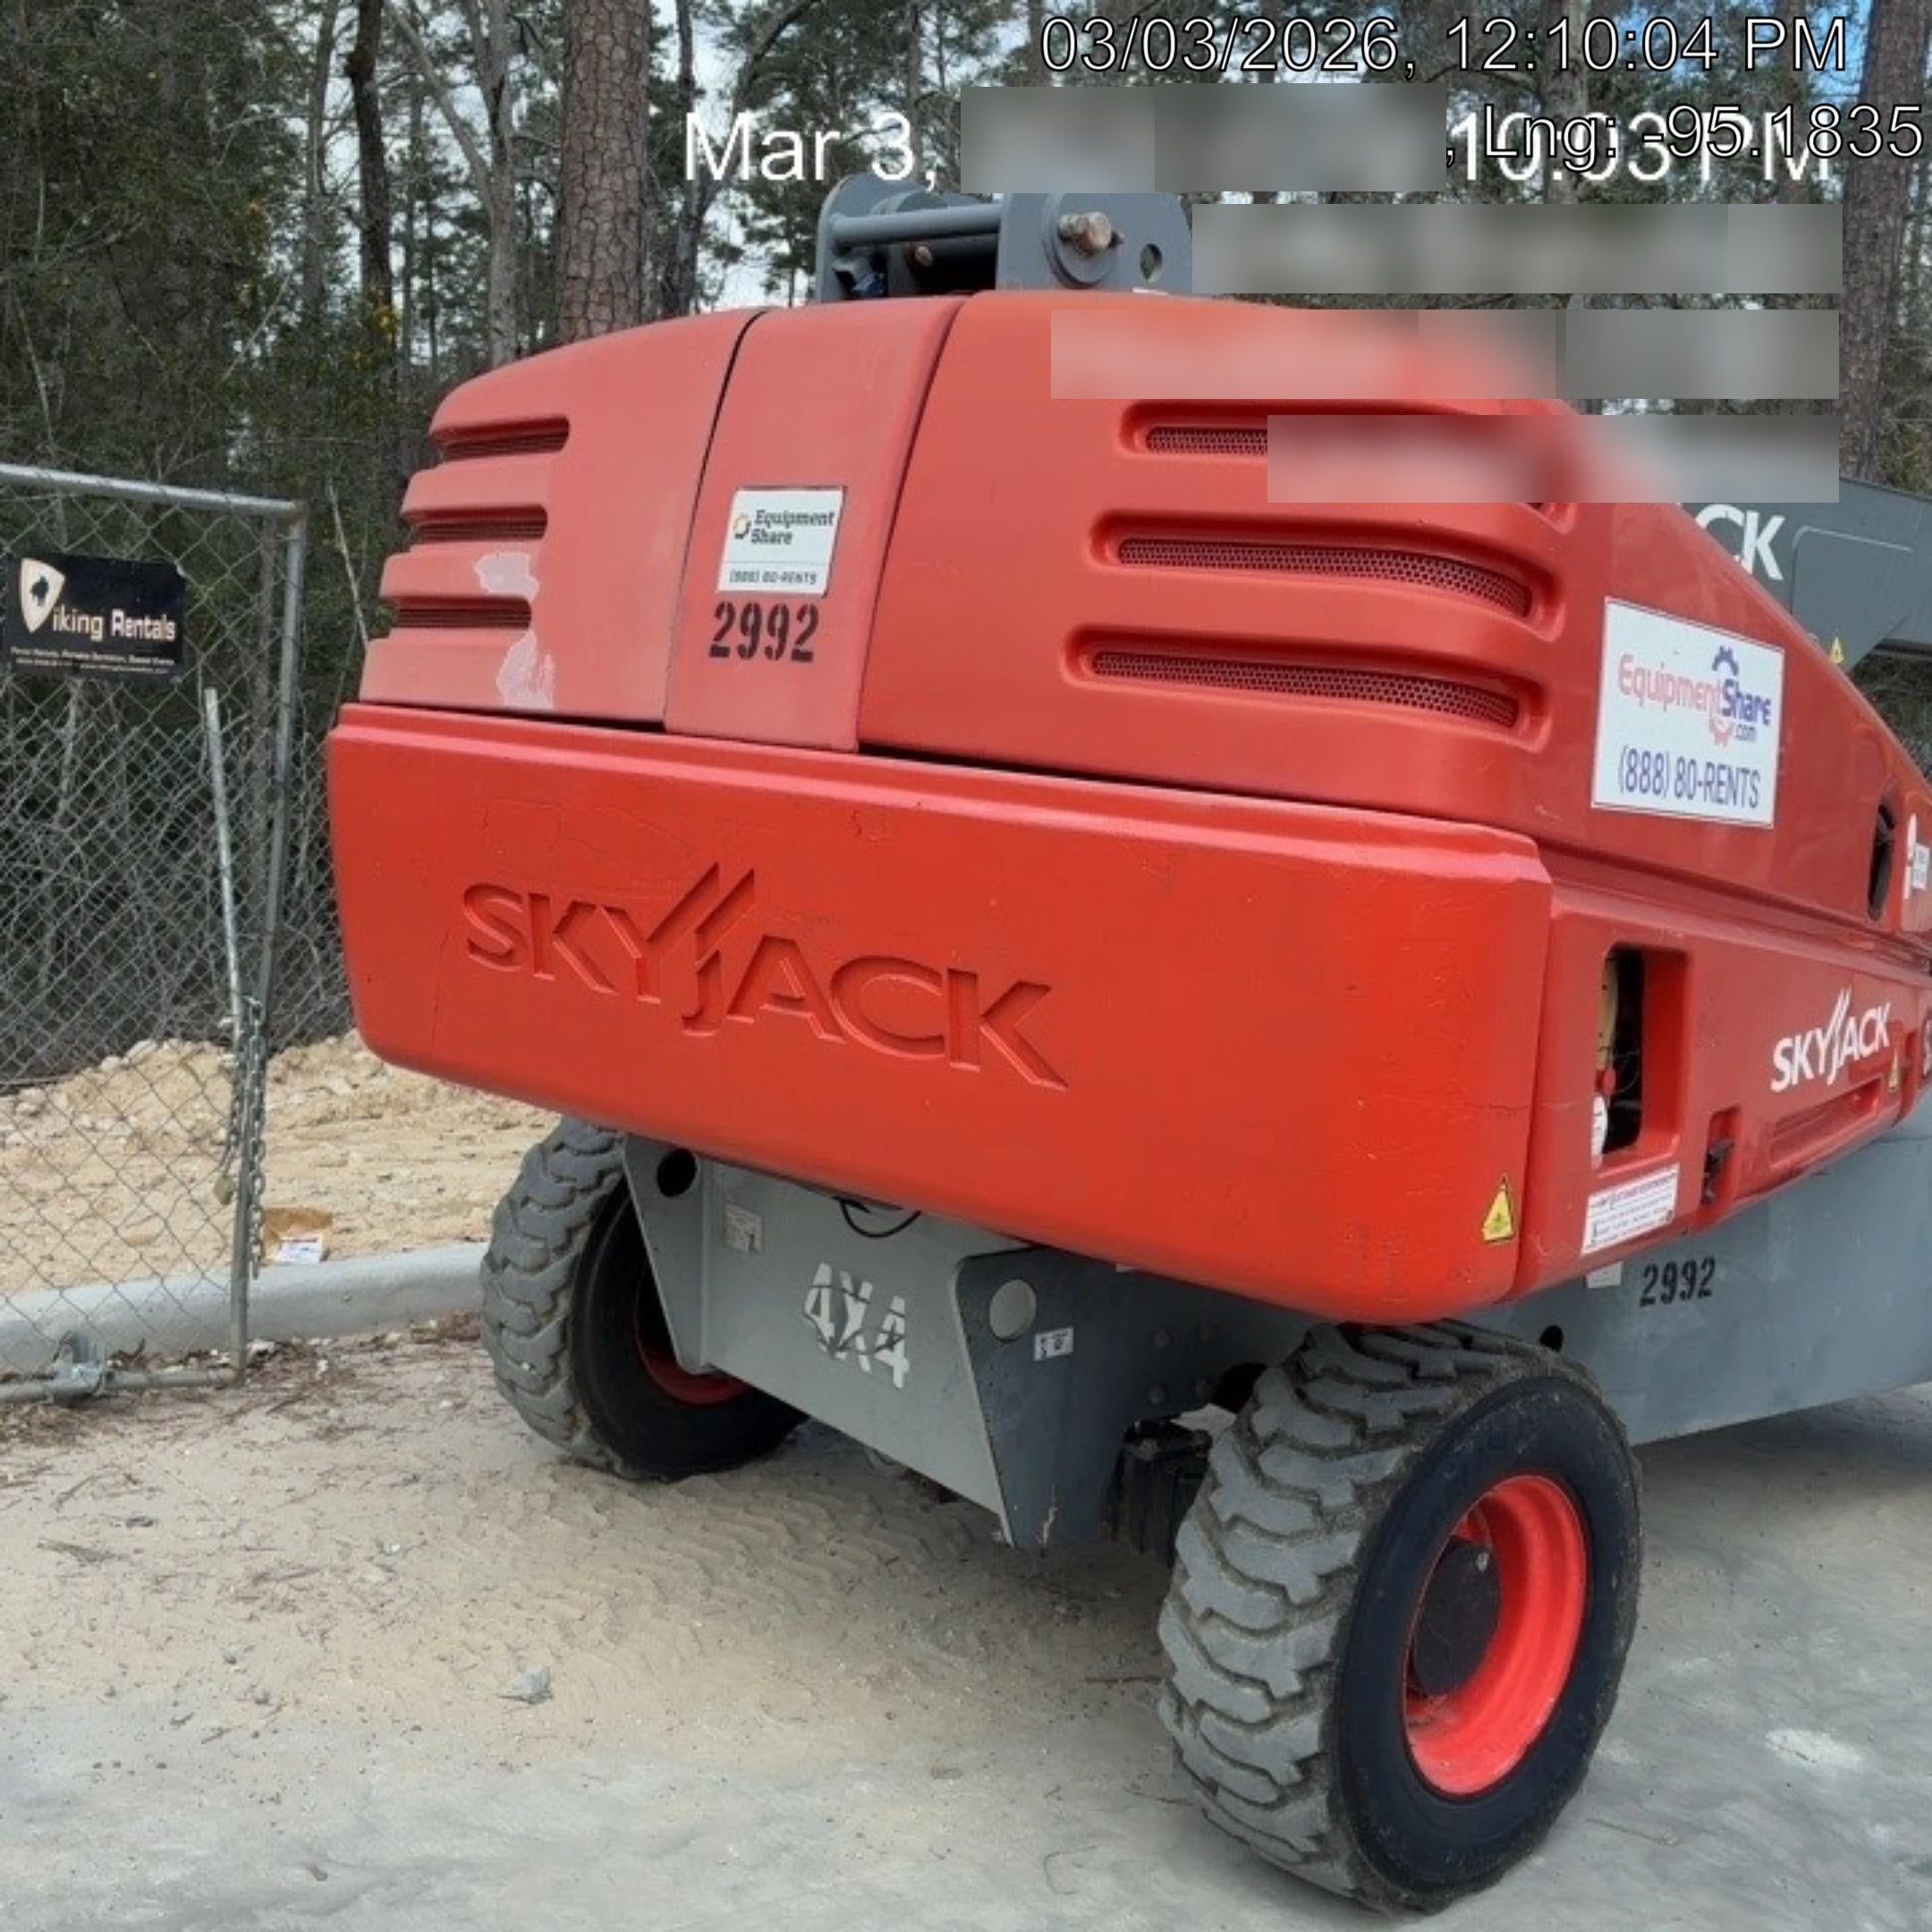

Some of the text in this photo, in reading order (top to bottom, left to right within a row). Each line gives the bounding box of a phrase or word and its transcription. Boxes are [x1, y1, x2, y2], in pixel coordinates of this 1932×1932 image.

[750, 529, 792, 545] Share
[754, 510, 835, 530] Equipment
[111, 608, 176, 641] Rentals
[708, 601, 819, 662] 2992
[1619, 745, 1761, 809] (888) 80-RENTS
[462, 860, 1070, 1093] SKYJACK
[1770, 986, 1891, 1092] SKYJACK
[1639, 1257, 1716, 1308] 2992
